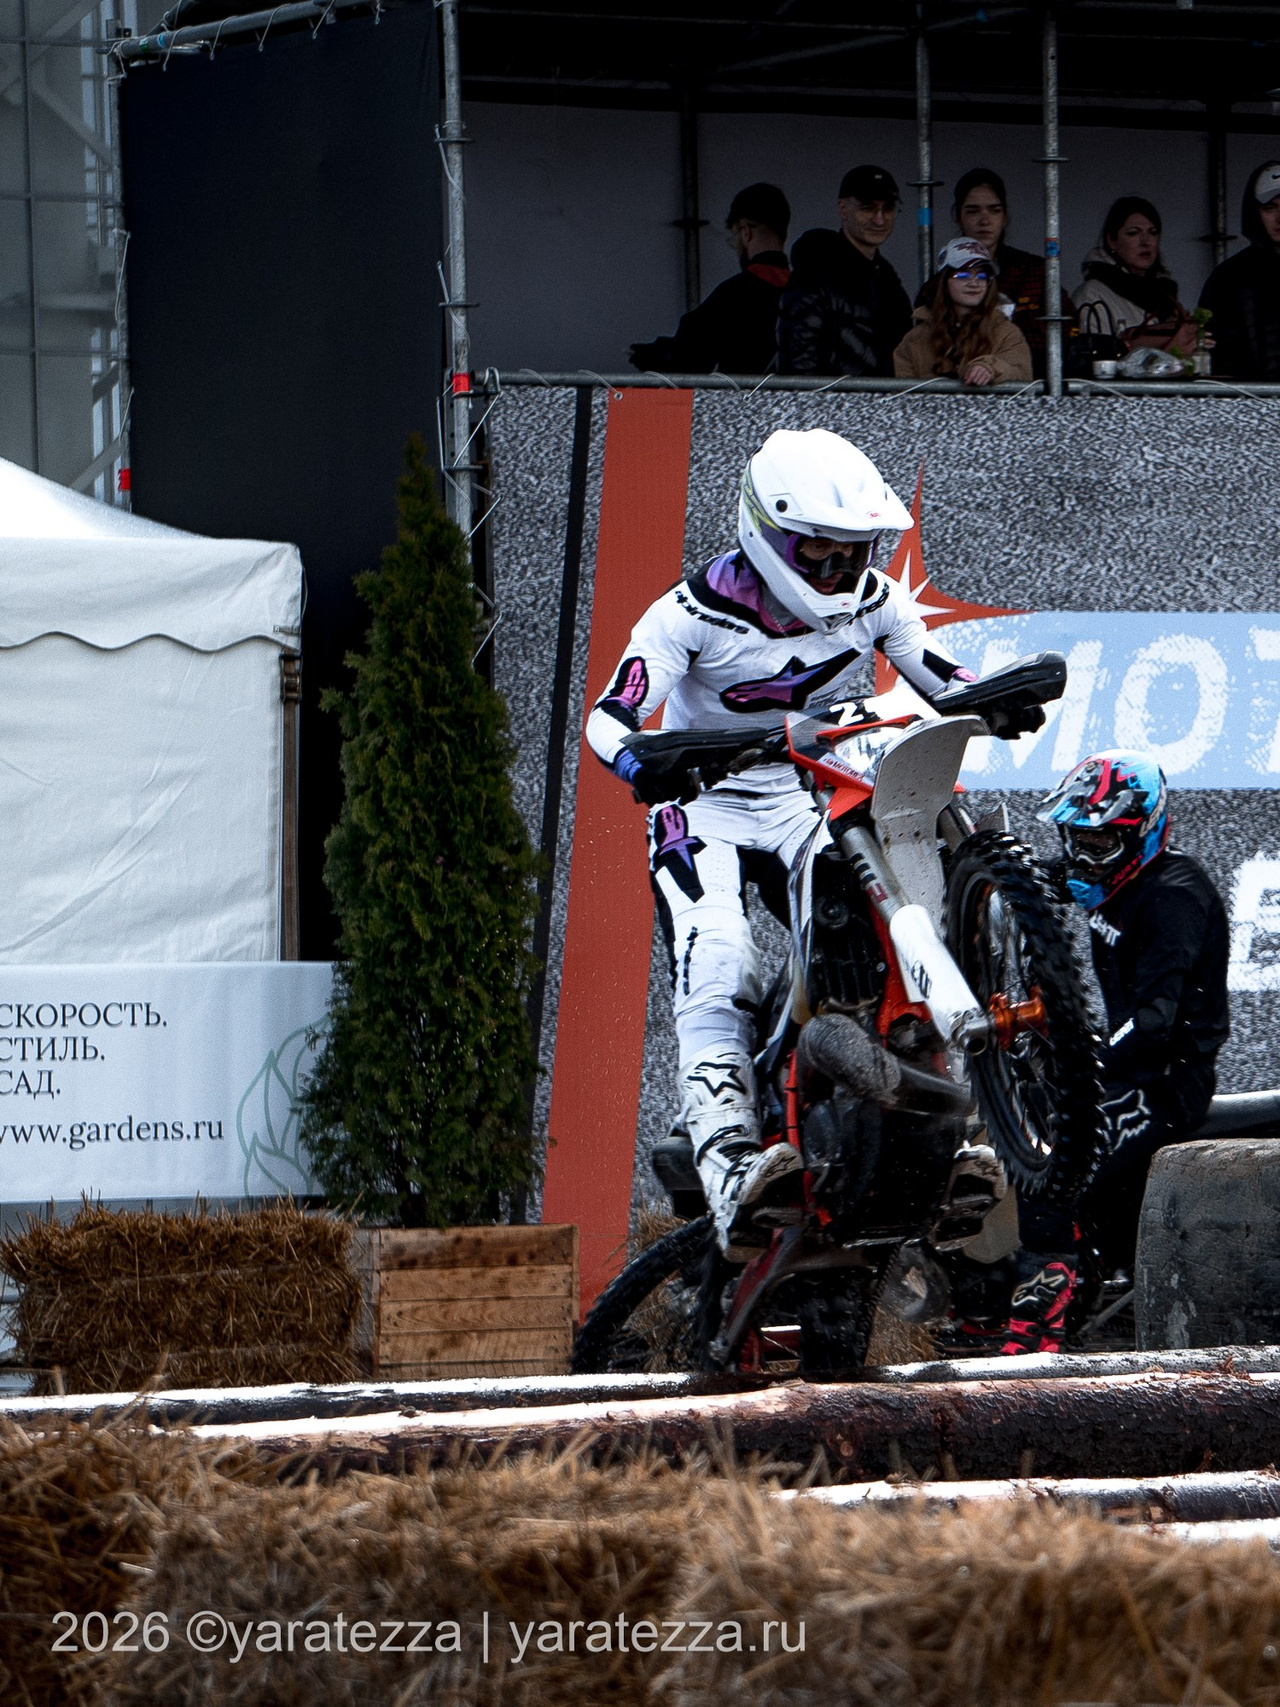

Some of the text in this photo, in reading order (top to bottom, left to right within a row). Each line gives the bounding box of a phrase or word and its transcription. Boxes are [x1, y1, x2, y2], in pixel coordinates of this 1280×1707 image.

[0, 1002, 168, 1029] СКОРОСТЬ.
[0, 1036, 105, 1062] СТИЛЬ.
[0, 1069, 61, 1100] САД.
